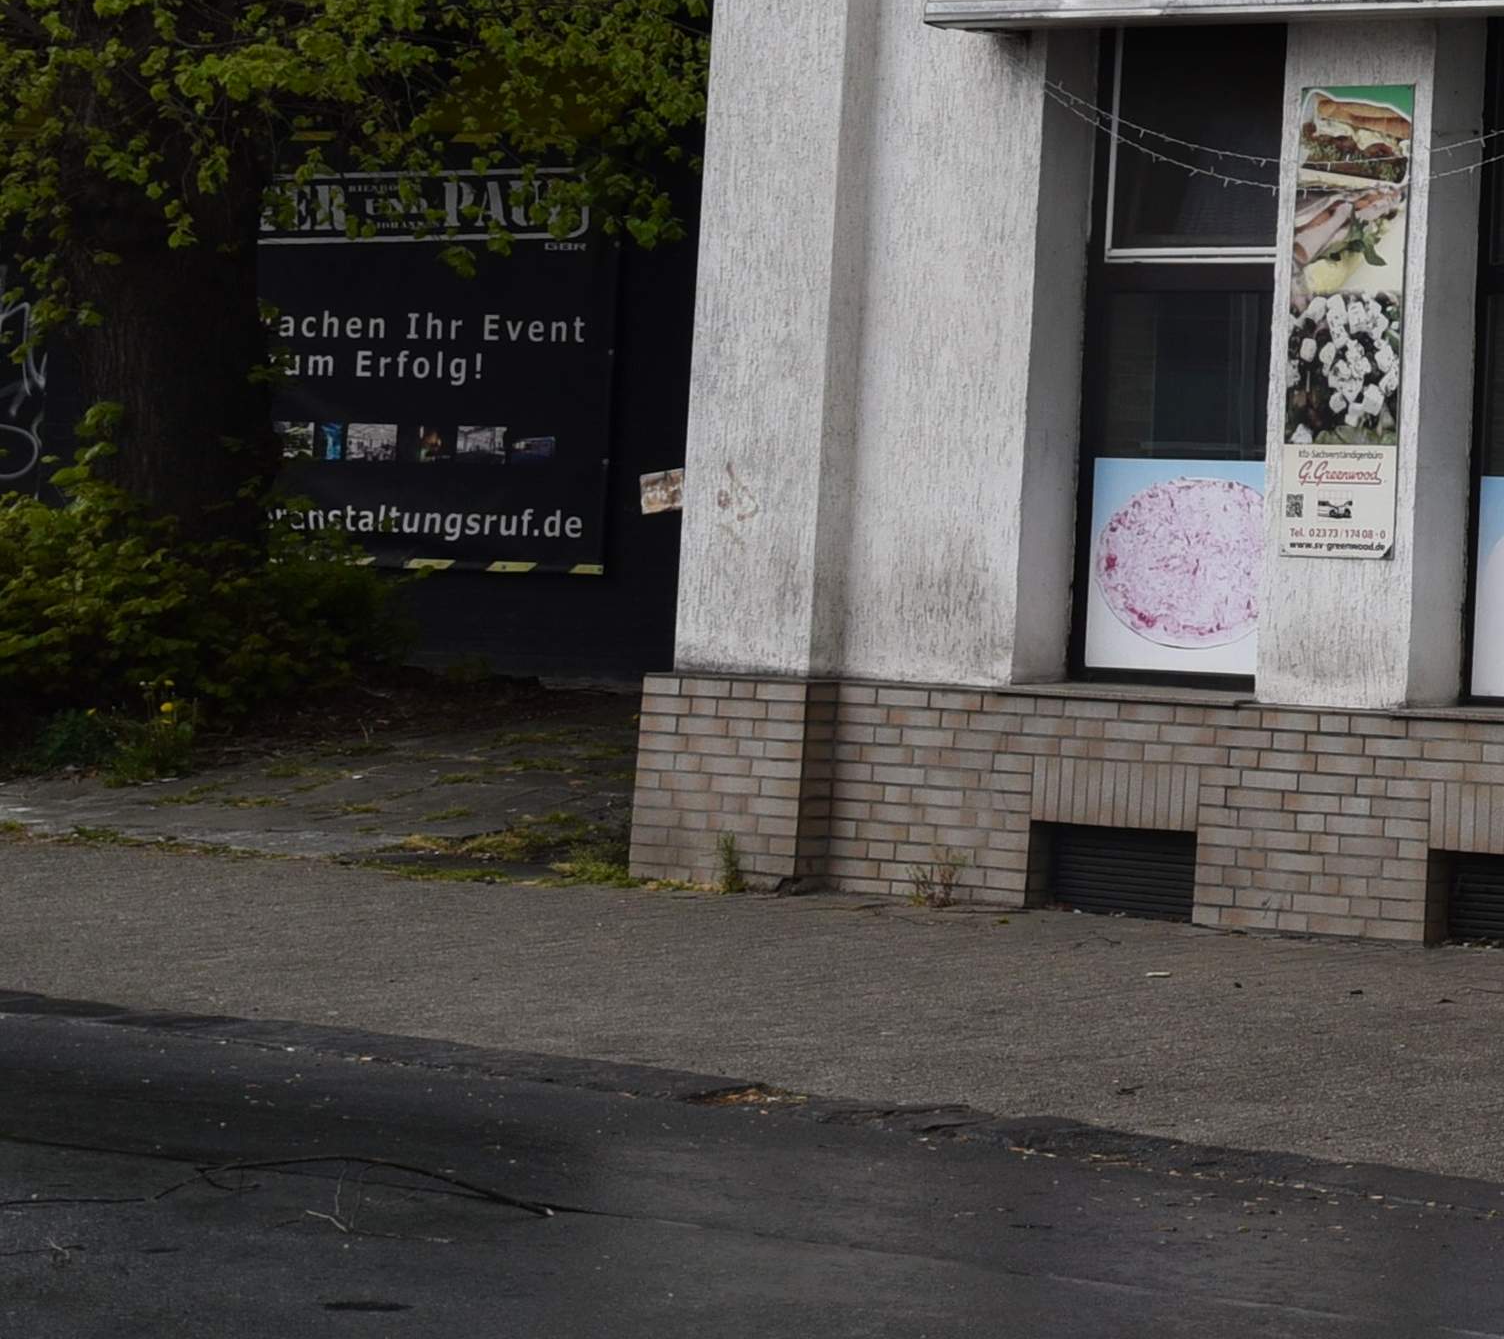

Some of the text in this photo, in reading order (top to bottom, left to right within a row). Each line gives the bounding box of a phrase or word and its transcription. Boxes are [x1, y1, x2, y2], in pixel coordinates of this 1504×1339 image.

[259, 310, 585, 343] achen Ihr Event
[356, 350, 483, 386] Erfolg!
[1313, 460, 1382, 486] Greenwood
[1289, 527, 1304, 538] Tel.
